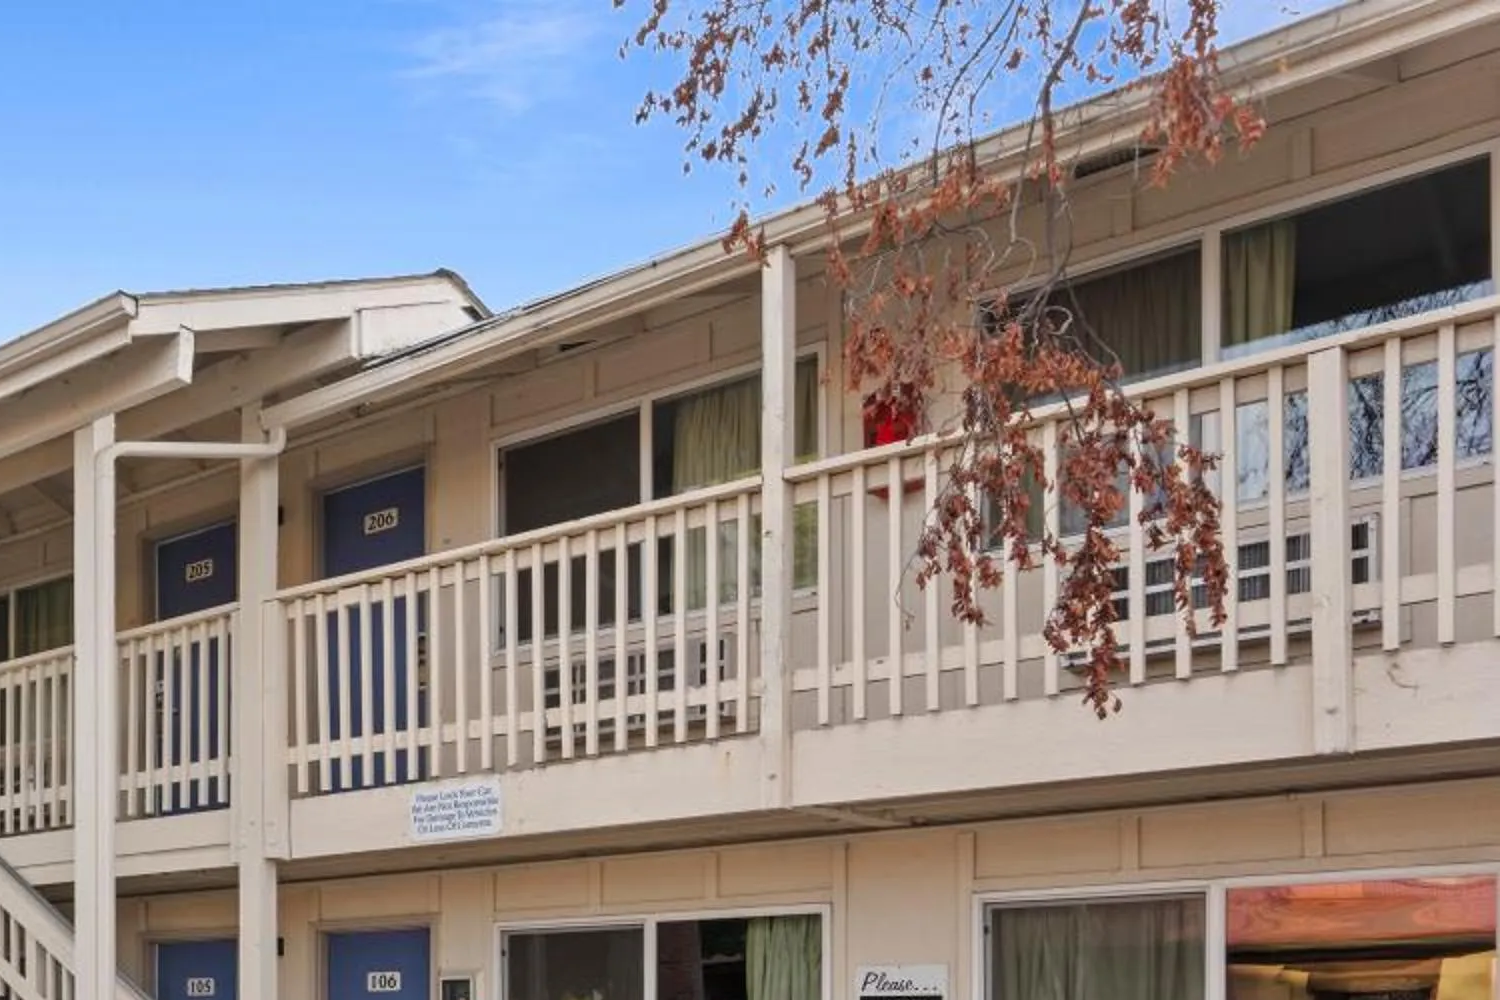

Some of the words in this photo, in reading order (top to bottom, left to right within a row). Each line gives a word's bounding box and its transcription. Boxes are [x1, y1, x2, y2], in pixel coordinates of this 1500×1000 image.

[368, 512, 395, 531] 206
[189, 562, 212, 579] 205
[440, 790, 458, 801] Lock
[478, 785, 492, 797] Car
[191, 979, 211, 993] 105
[372, 974, 397, 989] 106
[861, 971, 938, 992] Please...
